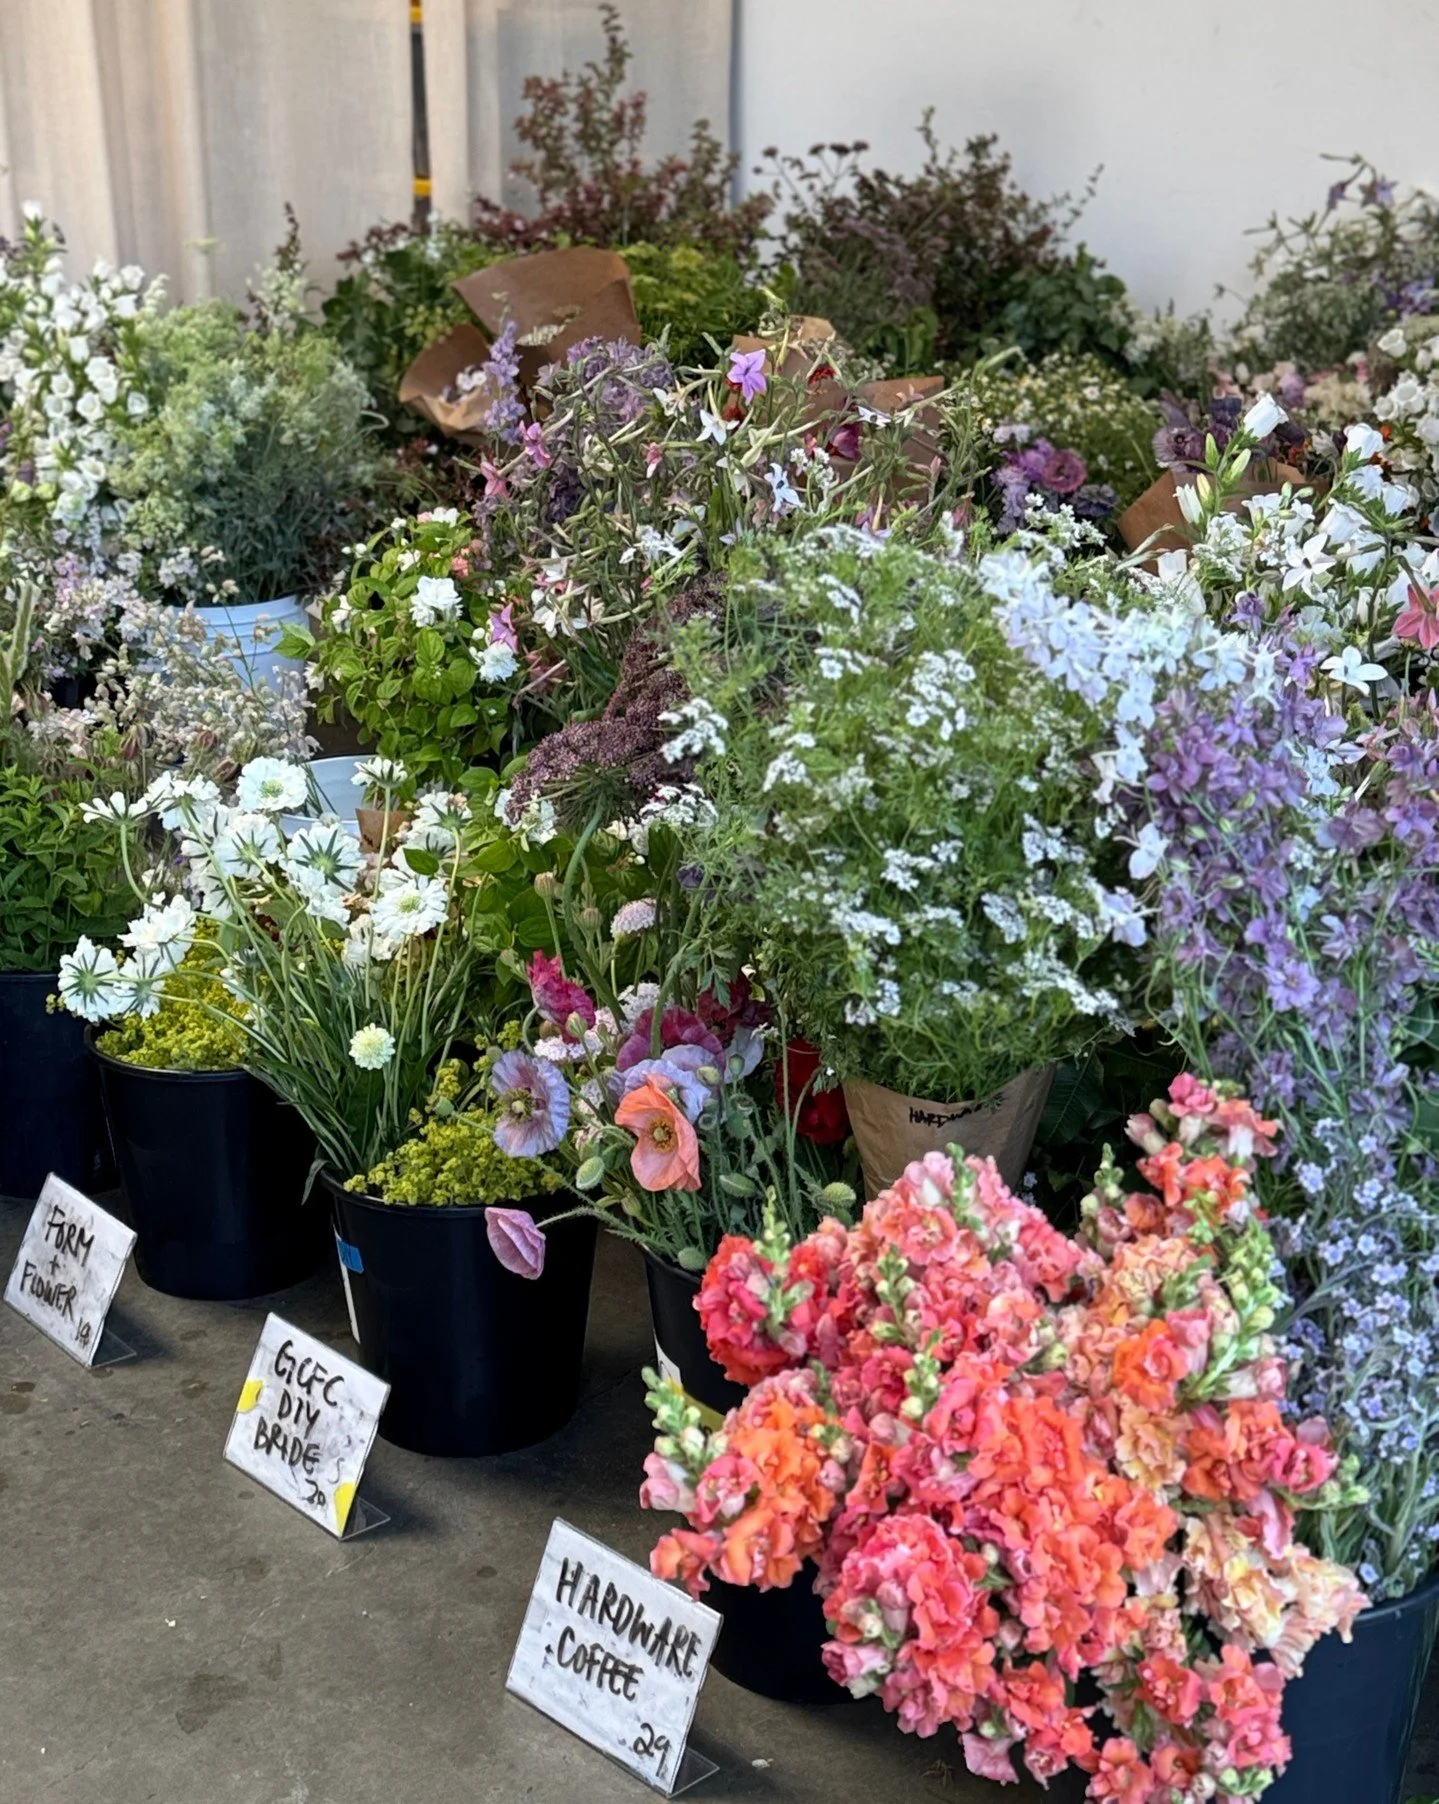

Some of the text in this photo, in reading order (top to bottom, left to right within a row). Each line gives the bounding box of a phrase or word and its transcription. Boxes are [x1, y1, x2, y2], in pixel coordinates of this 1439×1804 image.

[45, 1204, 95, 1267] FORM
[20, 1259, 77, 1321] FLOWER
[274, 1340, 345, 1407] GCFC
[277, 1388, 320, 1440] DIY
[556, 1557, 702, 1679] HARDWARE
[557, 1625, 645, 1702] COFFEE
[633, 1722, 671, 1778] 29
